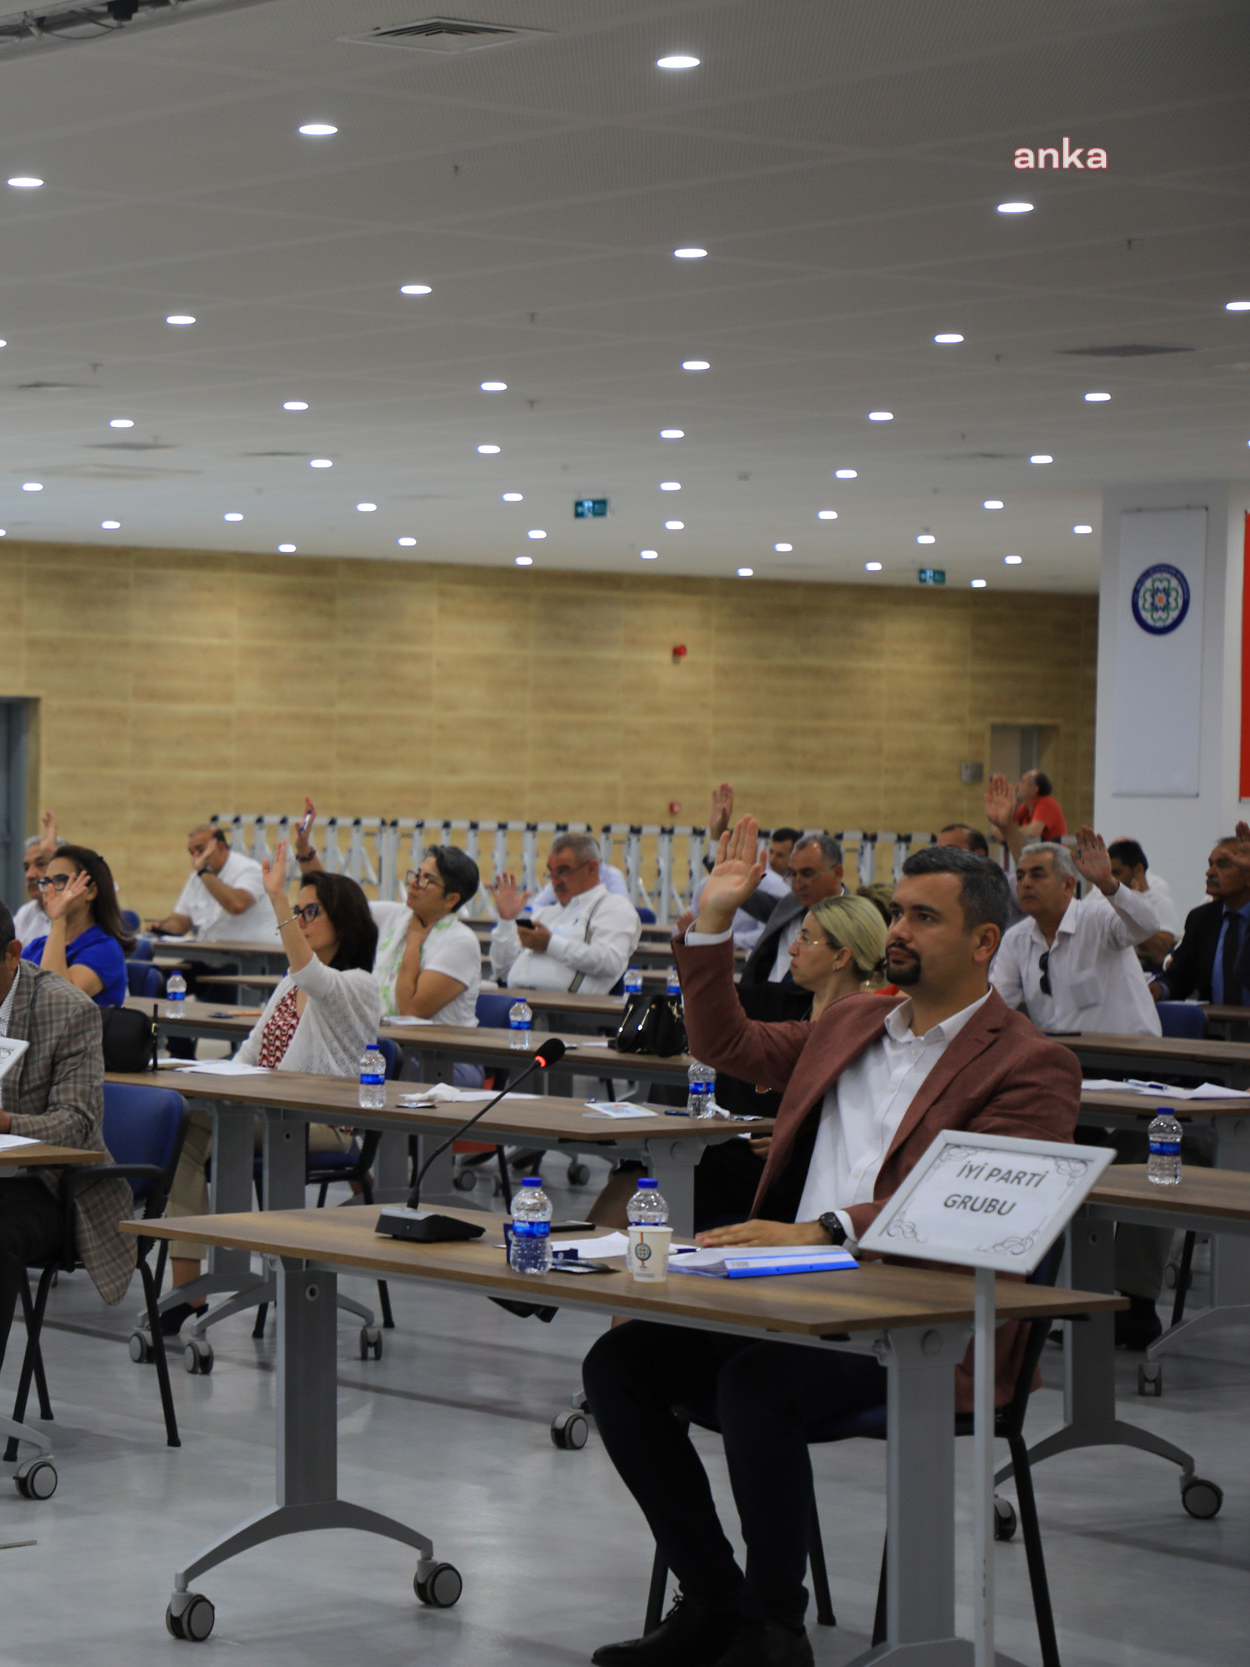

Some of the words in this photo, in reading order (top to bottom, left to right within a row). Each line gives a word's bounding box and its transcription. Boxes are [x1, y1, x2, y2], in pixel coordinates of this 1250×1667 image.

[956, 1160, 989, 1181] İYİ
[985, 1168, 1049, 1188] PARTİ
[943, 1193, 1017, 1216] GRUBU
